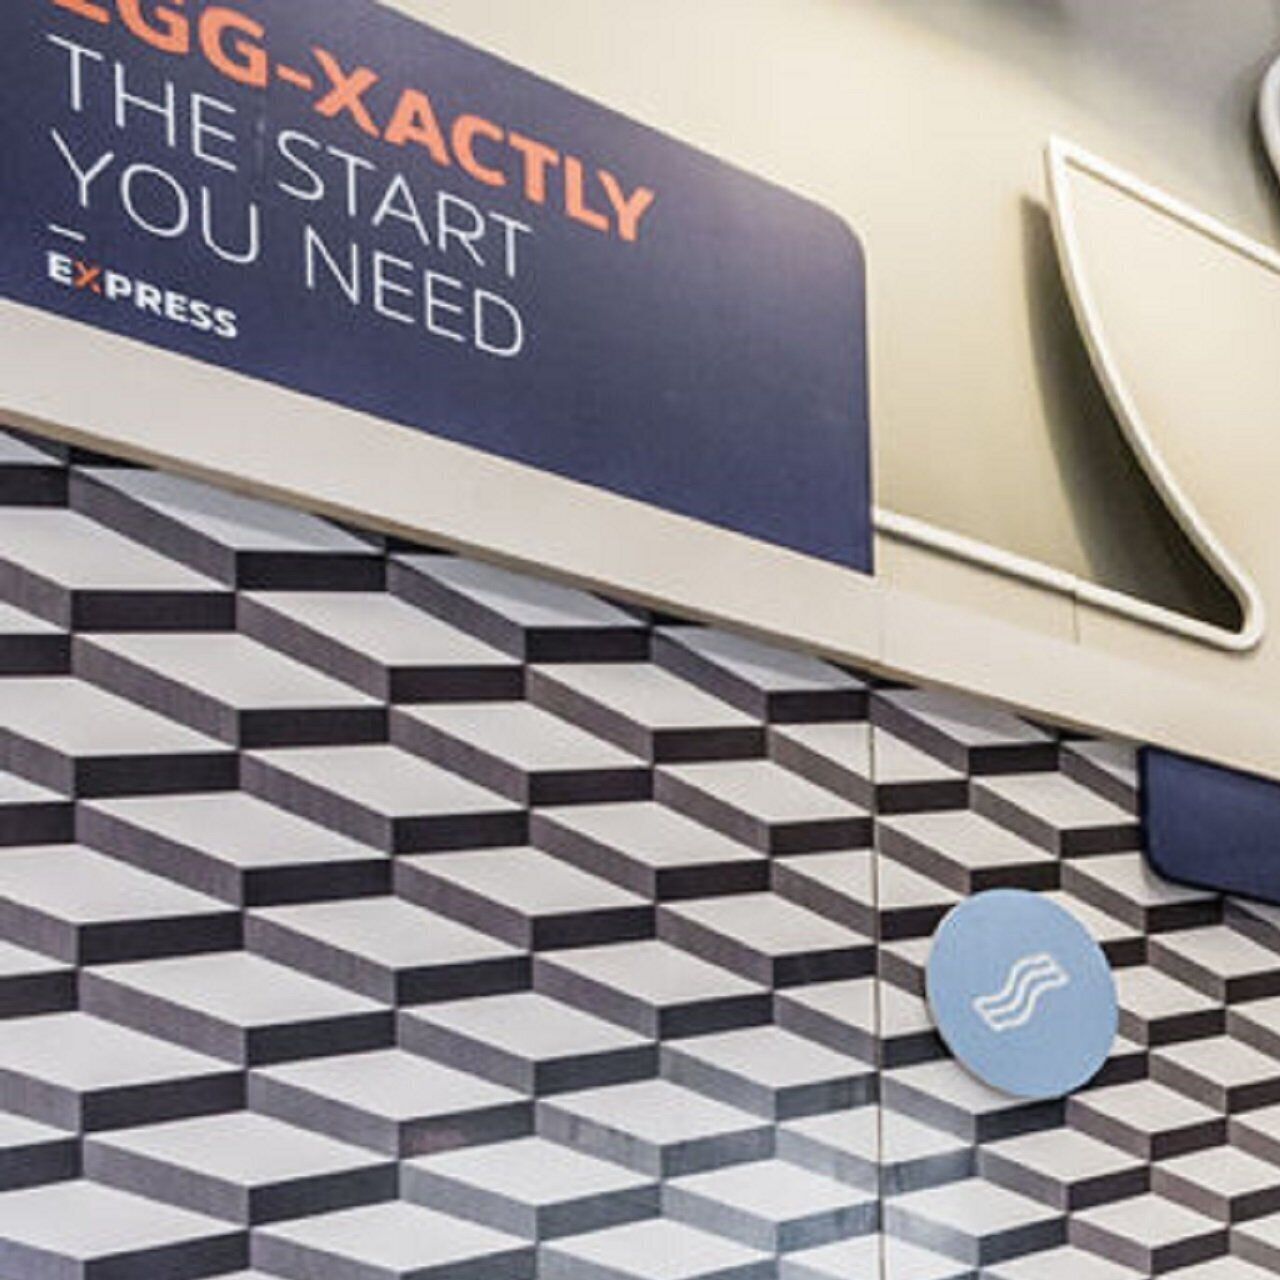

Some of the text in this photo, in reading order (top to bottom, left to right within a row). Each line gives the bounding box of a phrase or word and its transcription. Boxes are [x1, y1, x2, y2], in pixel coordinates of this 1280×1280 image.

[47, 34, 534, 278] THE START
[51, 127, 524, 358] YOU NEED
[47, 250, 239, 338] EXPRESS
